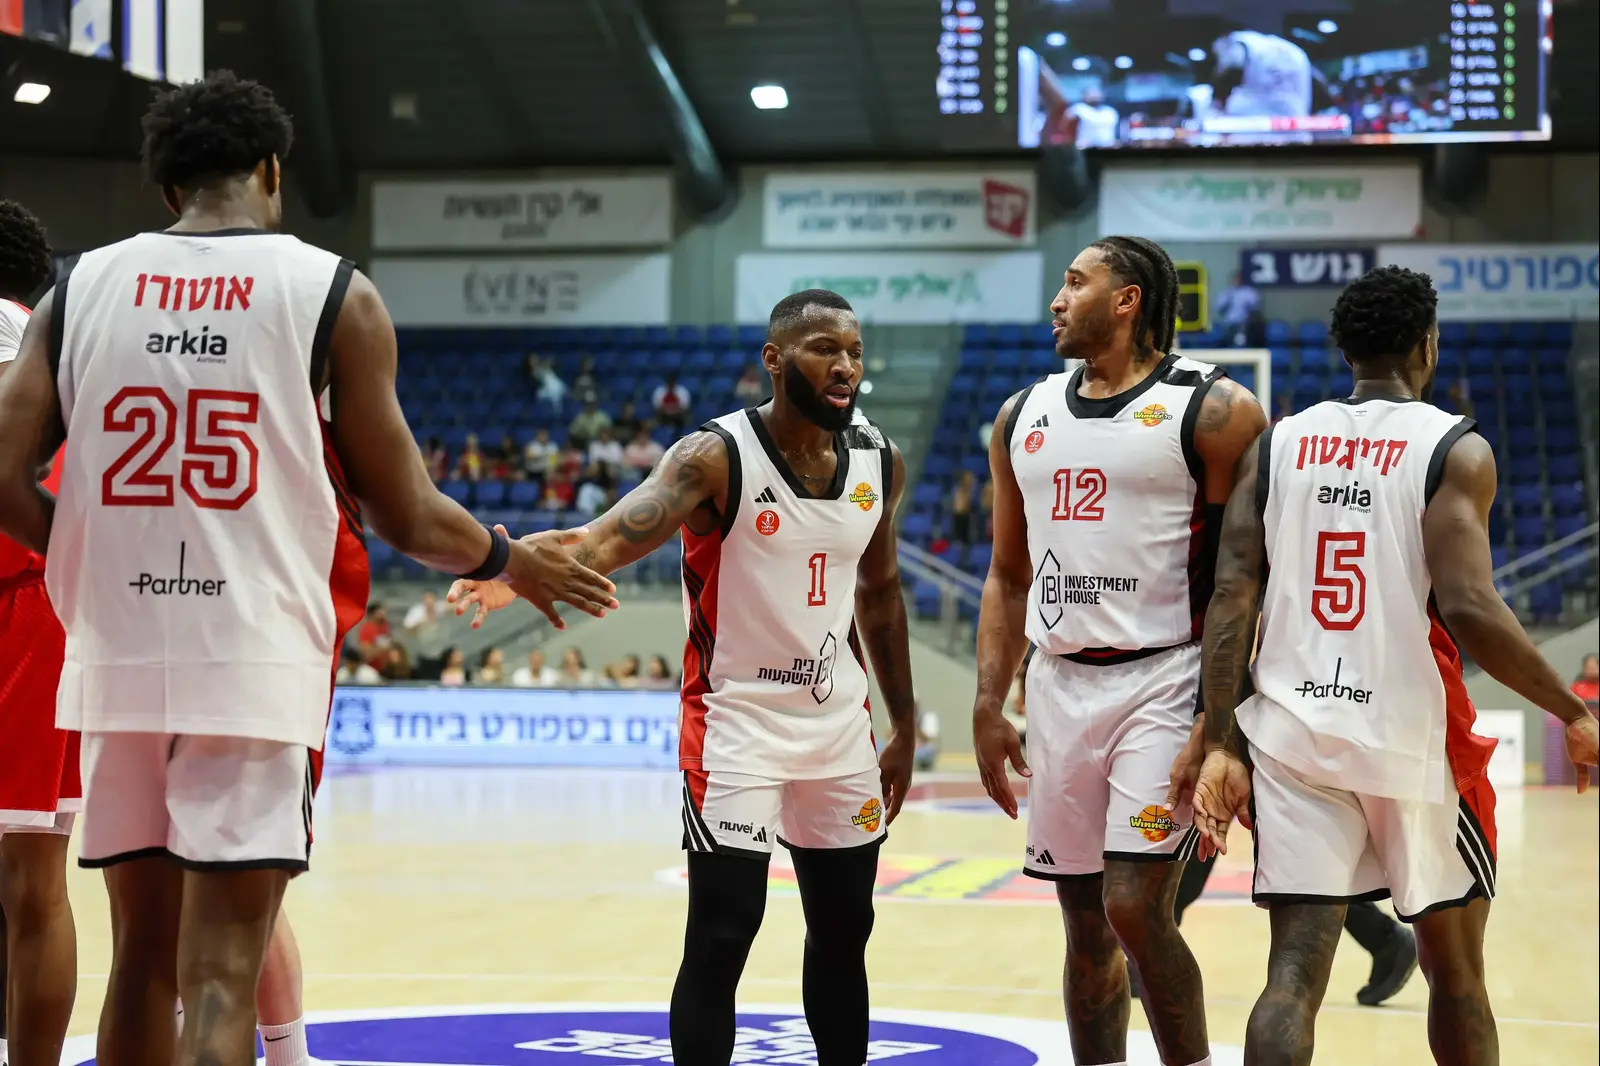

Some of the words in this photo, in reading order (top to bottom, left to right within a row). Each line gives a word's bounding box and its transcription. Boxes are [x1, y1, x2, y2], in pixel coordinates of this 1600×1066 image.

[1250, 253, 1279, 283] ב
[1290, 253, 1363, 283] גוש
[134, 273, 254, 312] אוטורו
[146, 325, 227, 355] arkia
[196, 356, 227, 364] Airlines
[102, 386, 259, 511] 25
[1052, 468, 1107, 521] 12
[1349, 505, 1372, 514] Airlines
[129, 541, 226, 596] Partner
[808, 553, 827, 606] 1
[1065, 575, 1138, 592] INVESTMENT
[1311, 531, 1366, 631] 5
[1065, 591, 1100, 605] HOUSE
[757, 667, 812, 685] השקעות
[792, 658, 814, 672] בית
[1294, 657, 1372, 703] Partner
[387, 711, 466, 740] ביחד
[481, 713, 611, 744] בספורט
[719, 820, 753, 834] nuvei
[1130, 816, 1171, 830] Winner
